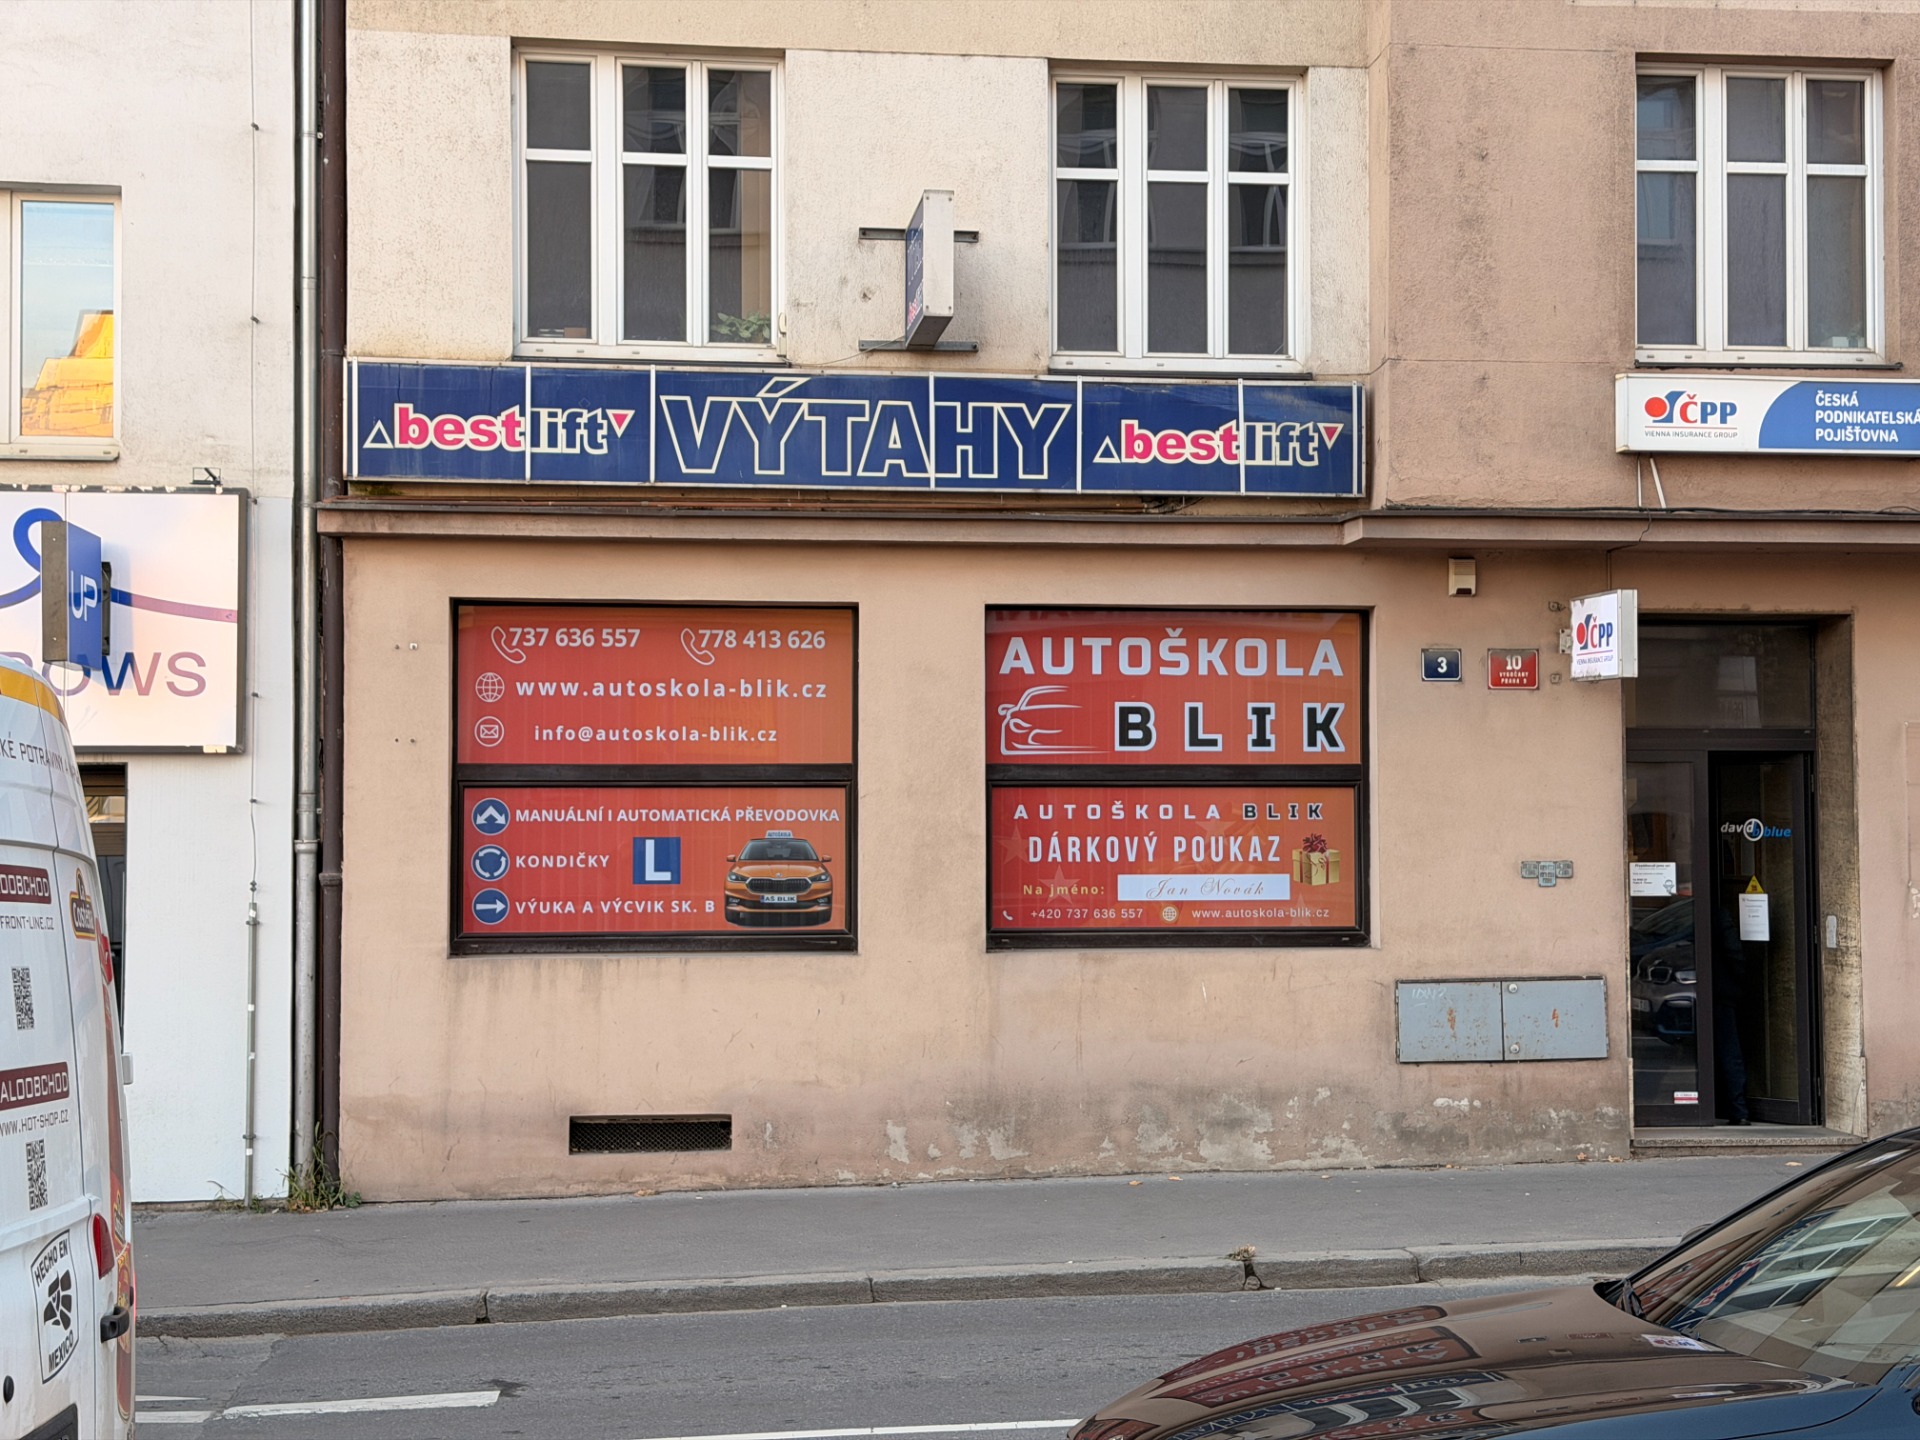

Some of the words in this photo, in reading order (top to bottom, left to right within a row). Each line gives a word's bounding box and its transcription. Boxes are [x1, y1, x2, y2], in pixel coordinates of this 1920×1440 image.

[1679, 393, 1738, 424] ČPP
[1815, 390, 1859, 407] ČESKÁ
[1815, 408, 1920, 425] PODNIKATELSKÁ
[659, 377, 1072, 479] VÝTAHY
[1713, 431, 1738, 439] GROUP
[1815, 425, 1899, 443] POJIŠŤOVNA
[508, 628, 549, 647] 737
[555, 628, 595, 647] 636
[601, 628, 641, 648] 557
[699, 629, 737, 649] 778
[743, 629, 781, 649] 413
[787, 630, 826, 649] 626
[1590, 616, 1613, 649] ČPP
[999, 627, 1344, 676] AUTOŠKOLA
[1437, 656, 1448, 673] 3
[1505, 654, 1522, 670] 10
[0, 651, 207, 697] OWS
[516, 678, 827, 698] www.autoskola-blik.cz
[534, 725, 778, 742] info@autoskola-blik.cz
[1114, 702, 1345, 752] BLIK
[0, 731, 17, 759] KÉ
[515, 805, 604, 822] MANUÁLNÍ
[608, 809, 613, 822] I
[617, 805, 731, 822] AUTOMATICKÁ
[735, 805, 840, 822] PŘEVODOVKA
[1013, 800, 1221, 820] AUTOŠKOLA
[1242, 803, 1323, 820] BLIK
[1029, 831, 1158, 862] DÁRKOVÝ
[1174, 836, 1281, 862] POUKAZ
[515, 852, 610, 868] KONDIČKY
[645, 839, 672, 881] L
[1023, 885, 1043, 895] Na
[1049, 884, 1105, 897] jméno:
[1146, 878, 1189, 899] Jan
[1200, 878, 1264, 896] Novák
[515, 897, 575, 914] VÝUKA
[582, 901, 593, 914] A
[600, 897, 664, 914] VÝCVIK
[671, 901, 697, 914] SK.
[705, 901, 715, 913] B
[1031, 908, 1061, 919] +420
[1066, 908, 1088, 919] 737
[1093, 908, 1116, 919] 636
[1121, 908, 1143, 919] 557
[1192, 907, 1330, 918] www.autoskola-blik.cz
[0, 1072, 68, 1104] ALOOBCHOD
[34, 1245, 58, 1288] HECHO
[59, 1238, 69, 1259] EN
[48, 1329, 74, 1373] MEXICO
